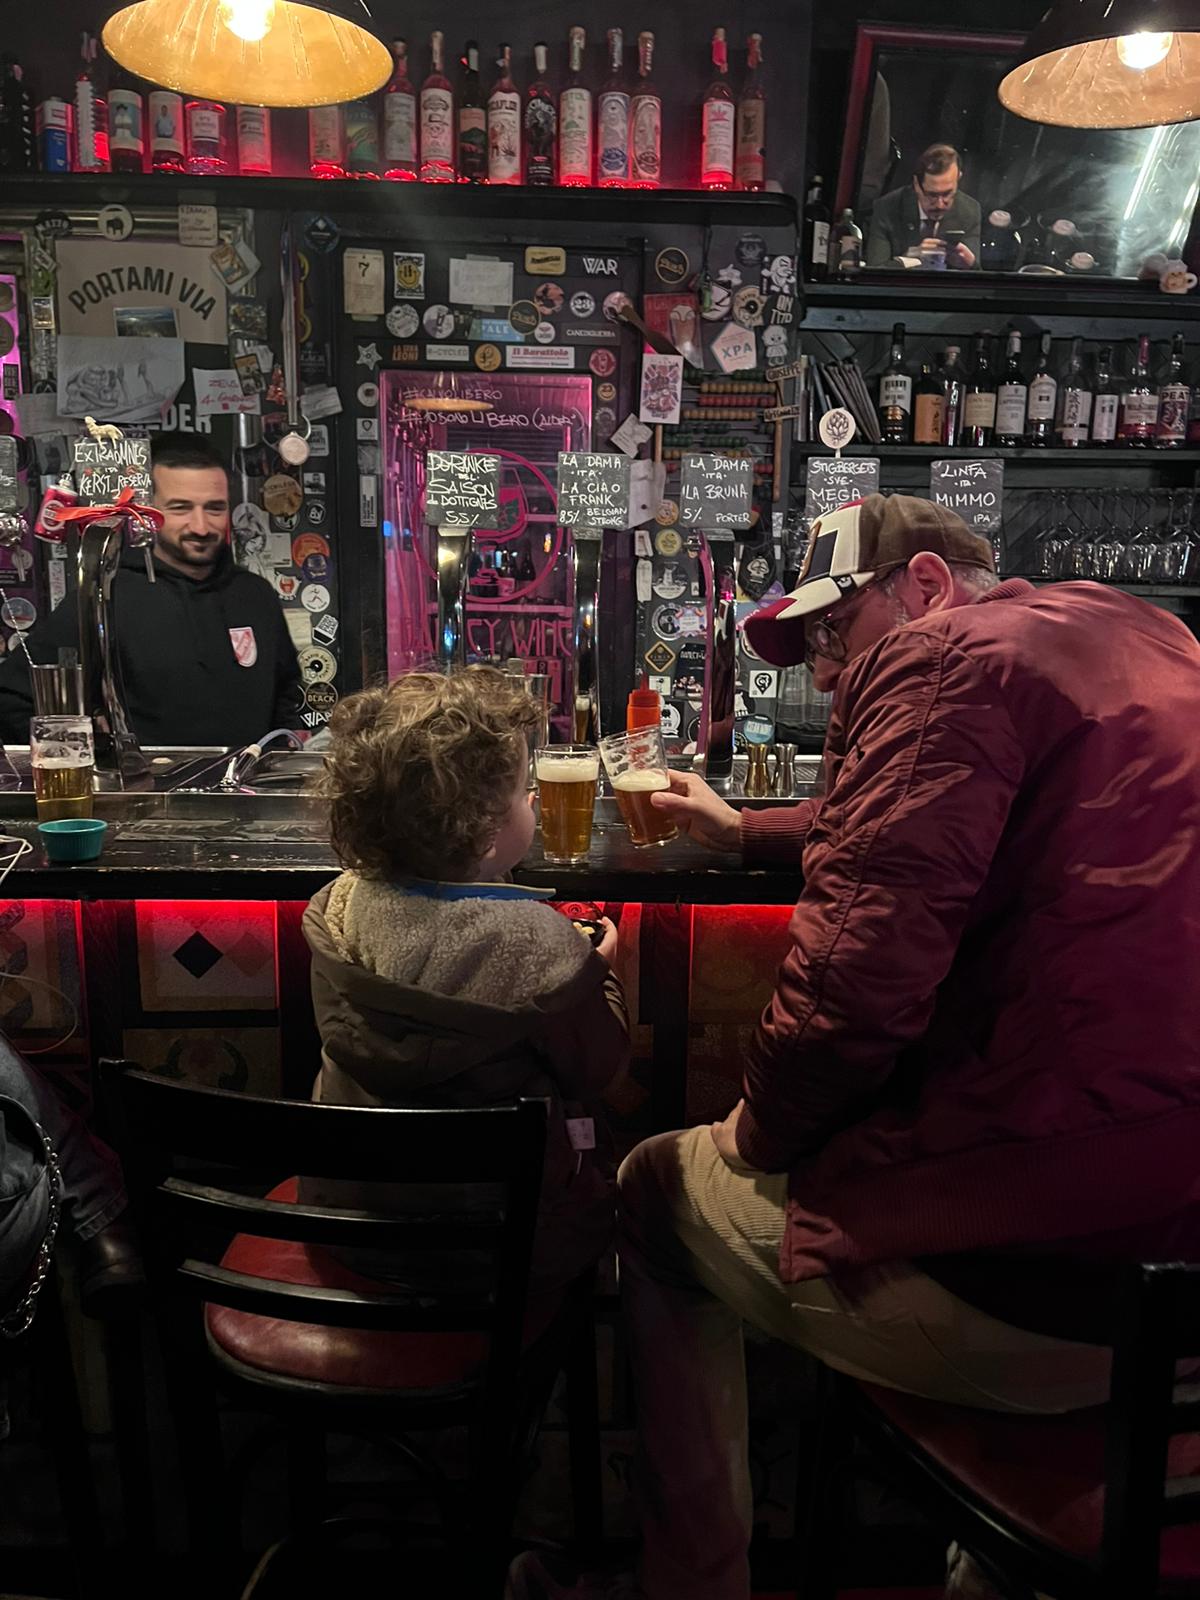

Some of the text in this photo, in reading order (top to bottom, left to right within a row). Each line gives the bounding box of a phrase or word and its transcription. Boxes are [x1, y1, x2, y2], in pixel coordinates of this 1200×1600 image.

[583, 257, 618, 275] WAR
[68, 266, 216, 320] PORTAMI VIA
[721, 342, 753, 359] XPA
[585, 456, 622, 469] DAMA
[690, 457, 750, 472] LA DAMA
[80, 470, 111, 498] KERST
[427, 479, 495, 498] SAISON
[561, 482, 621, 494] LA CIAO
[704, 483, 749, 500] BRUNA
[568, 493, 615, 507] FRANK
[808, 487, 862, 502] MEGA
[935, 491, 996, 507] MIMMO
[715, 512, 752, 523] PORTER
[973, 513, 991, 525] IPA
[307, 694, 335, 703] BLACK
